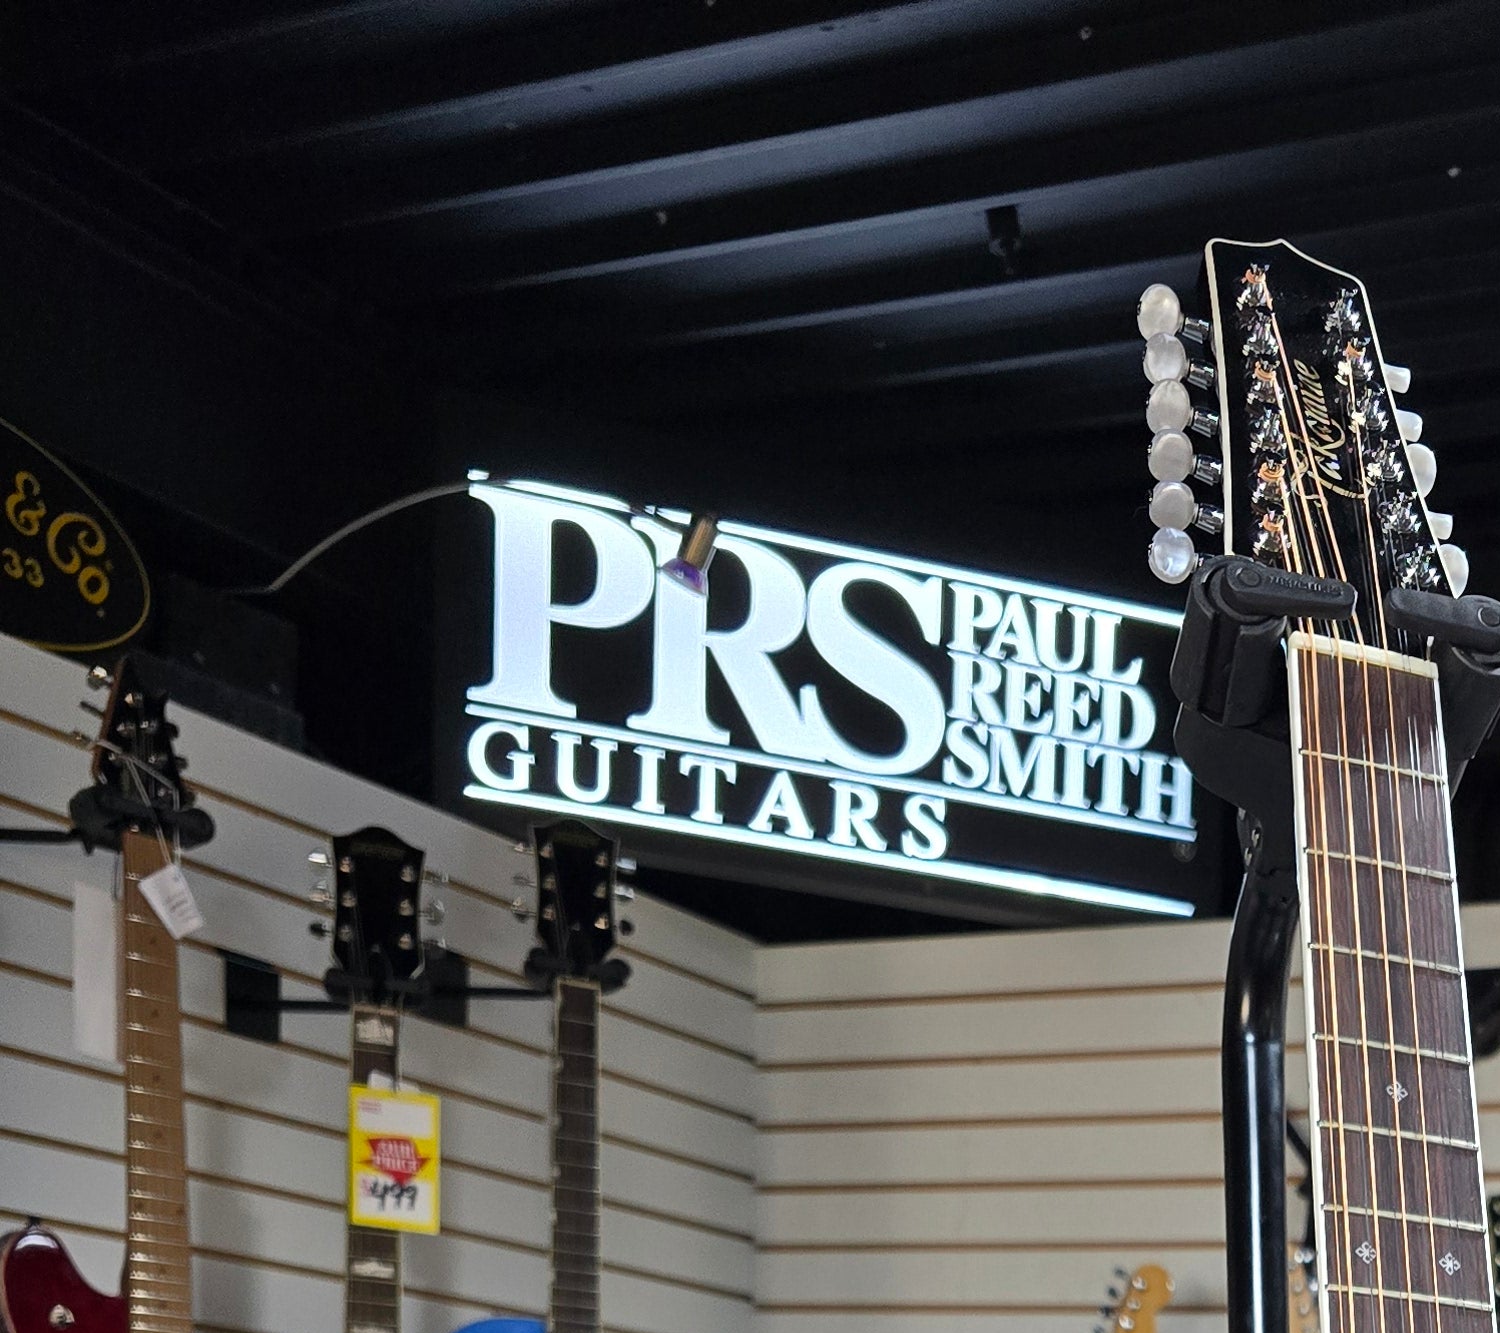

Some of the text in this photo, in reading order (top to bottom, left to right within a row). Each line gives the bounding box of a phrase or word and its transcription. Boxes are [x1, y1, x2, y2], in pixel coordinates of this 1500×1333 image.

[5, 470, 47, 536] &
[465, 481, 947, 776] PRS
[947, 580, 1143, 686] PAUL
[947, 652, 1158, 752] REED
[465, 721, 949, 861] GUITARS
[943, 720, 1196, 831] SMITH
